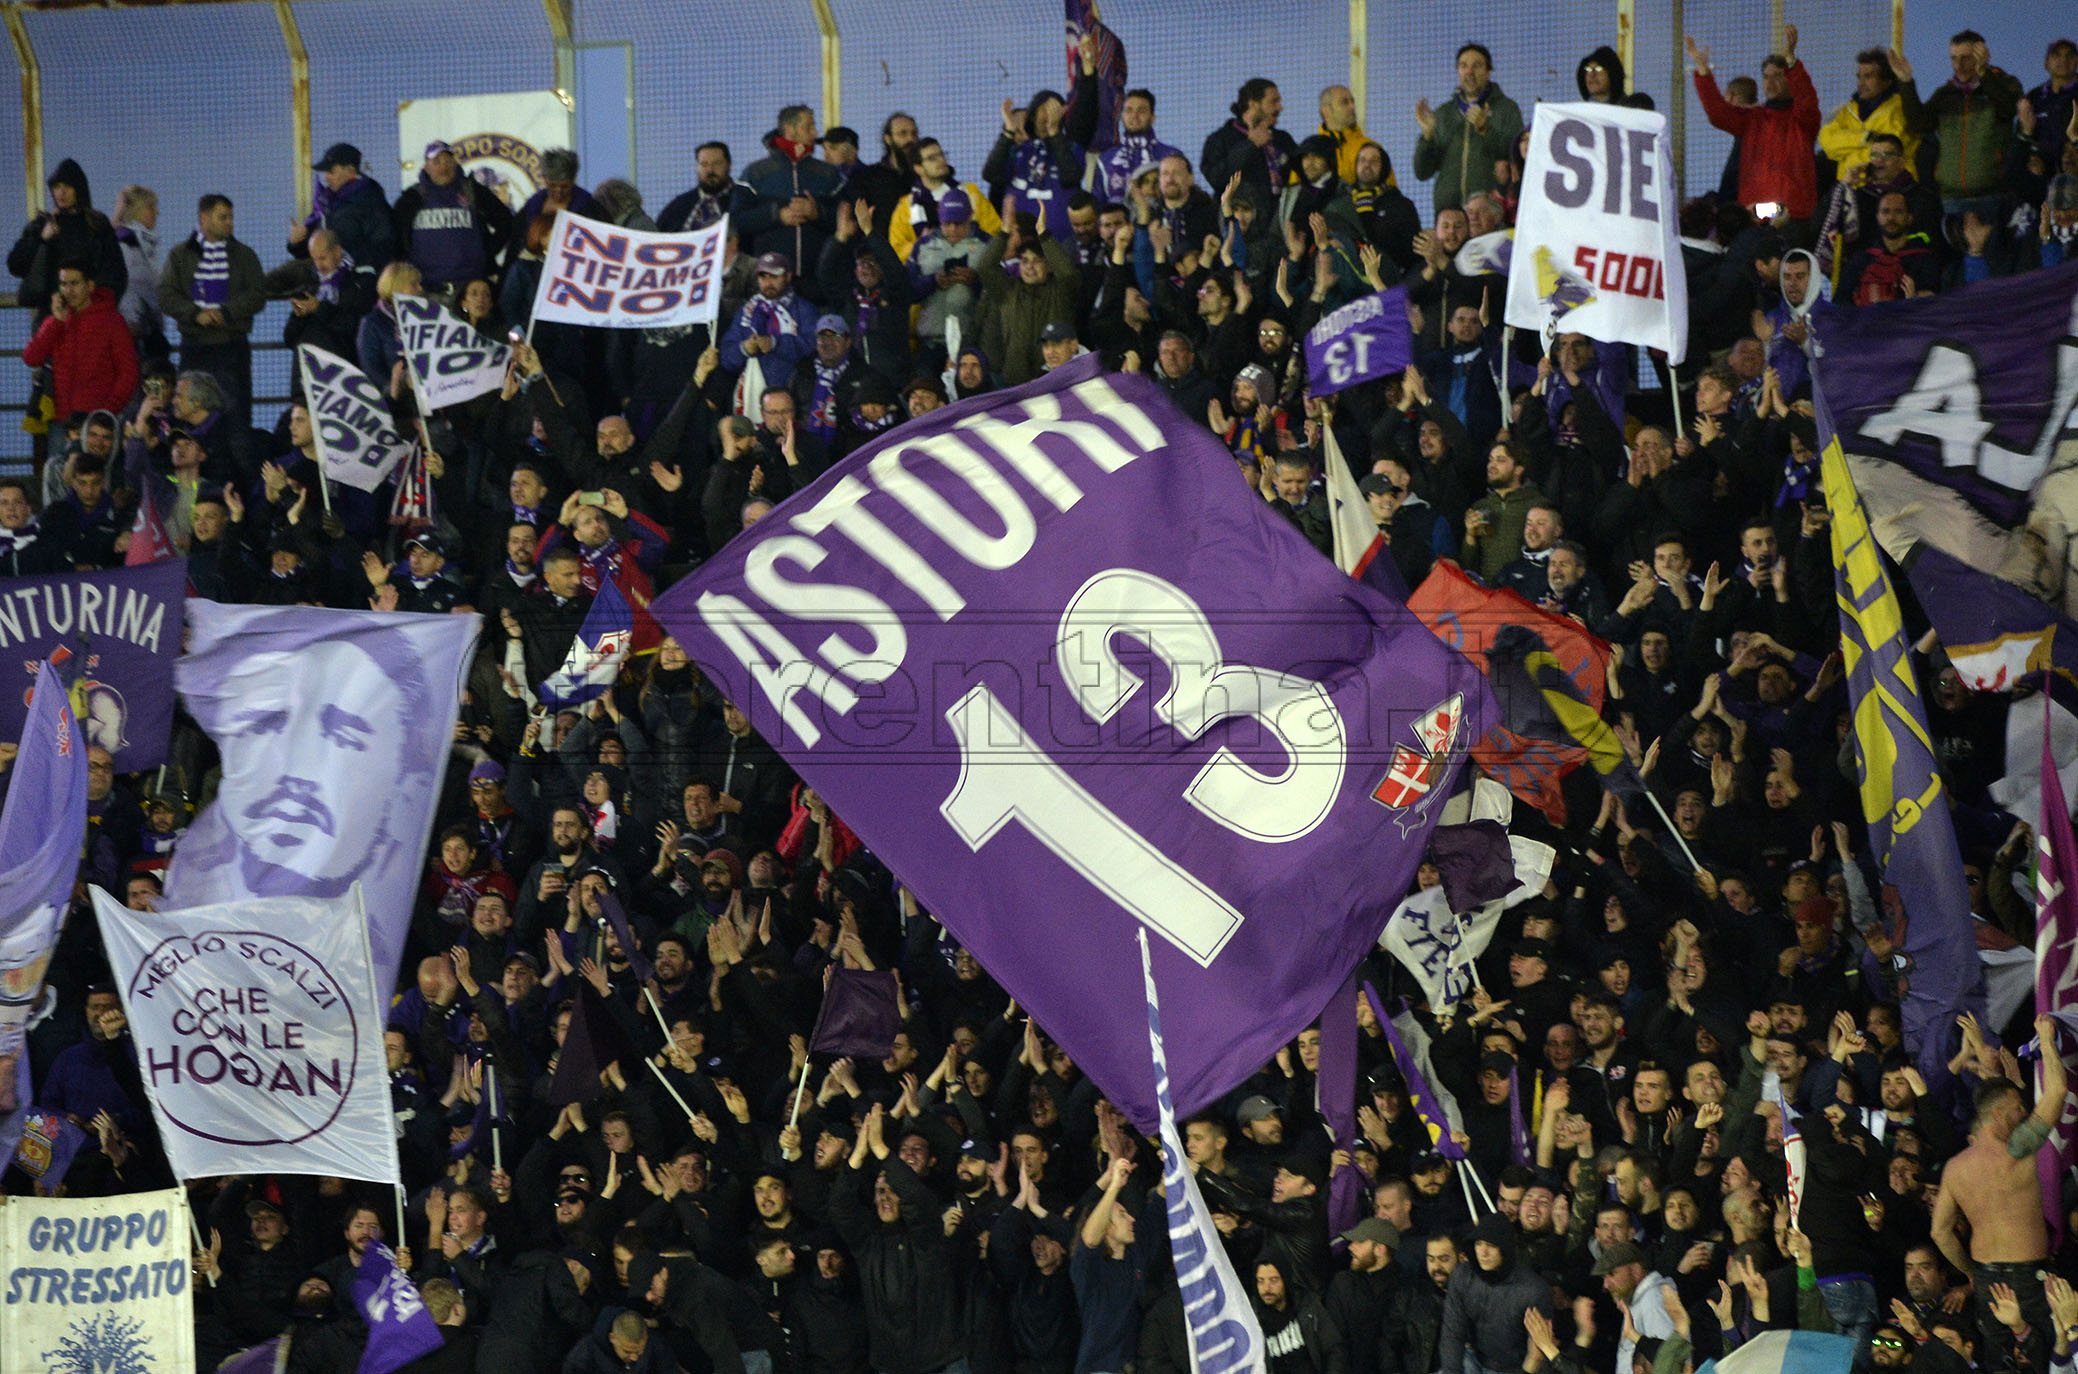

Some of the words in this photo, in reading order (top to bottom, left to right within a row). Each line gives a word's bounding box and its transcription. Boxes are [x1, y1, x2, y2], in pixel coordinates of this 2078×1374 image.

[561, 250, 713, 290] TIFIAMO
[695, 377, 1168, 749] ASTORI
[939, 567, 1347, 969] 13
[137, 937, 226, 1000] MEGLIO
[239, 941, 338, 1010] SCALZI
[194, 987, 270, 1016] CHE
[172, 1008, 247, 1047] CON
[261, 1021, 305, 1050] LE
[147, 1044, 343, 1097] HOGAN
[28, 1208, 167, 1256] GRUPPO
[6, 1257, 186, 1307] STRESSATO
